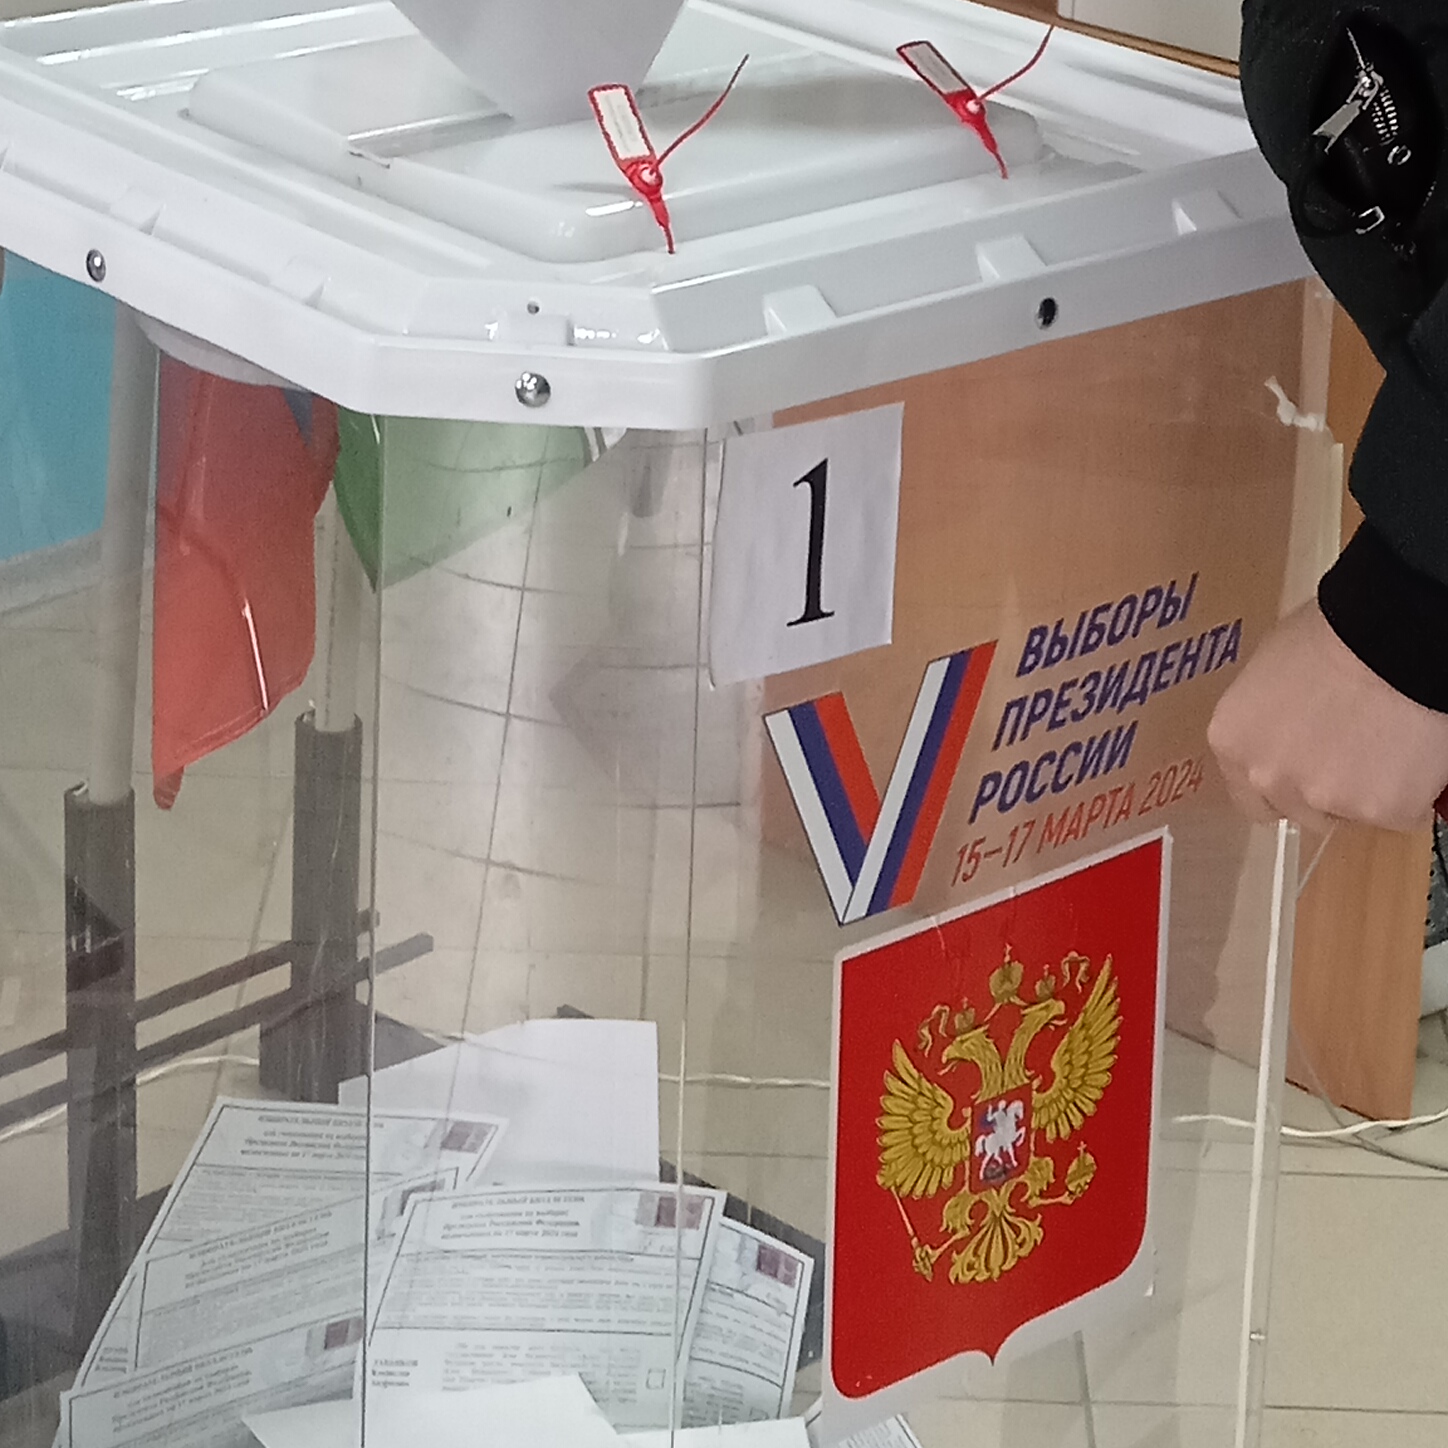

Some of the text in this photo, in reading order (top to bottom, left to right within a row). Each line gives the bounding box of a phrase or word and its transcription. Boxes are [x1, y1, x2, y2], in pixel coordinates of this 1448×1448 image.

[787, 457, 835, 627] 1
[1015, 570, 1200, 678] ВЫБОРЫ
[991, 617, 1243, 753] ПРЕЗИДЕНТА
[968, 720, 1139, 825] РОССИИ
[1036, 782, 1136, 854] МАРТА
[1137, 758, 1204, 817] 2024
